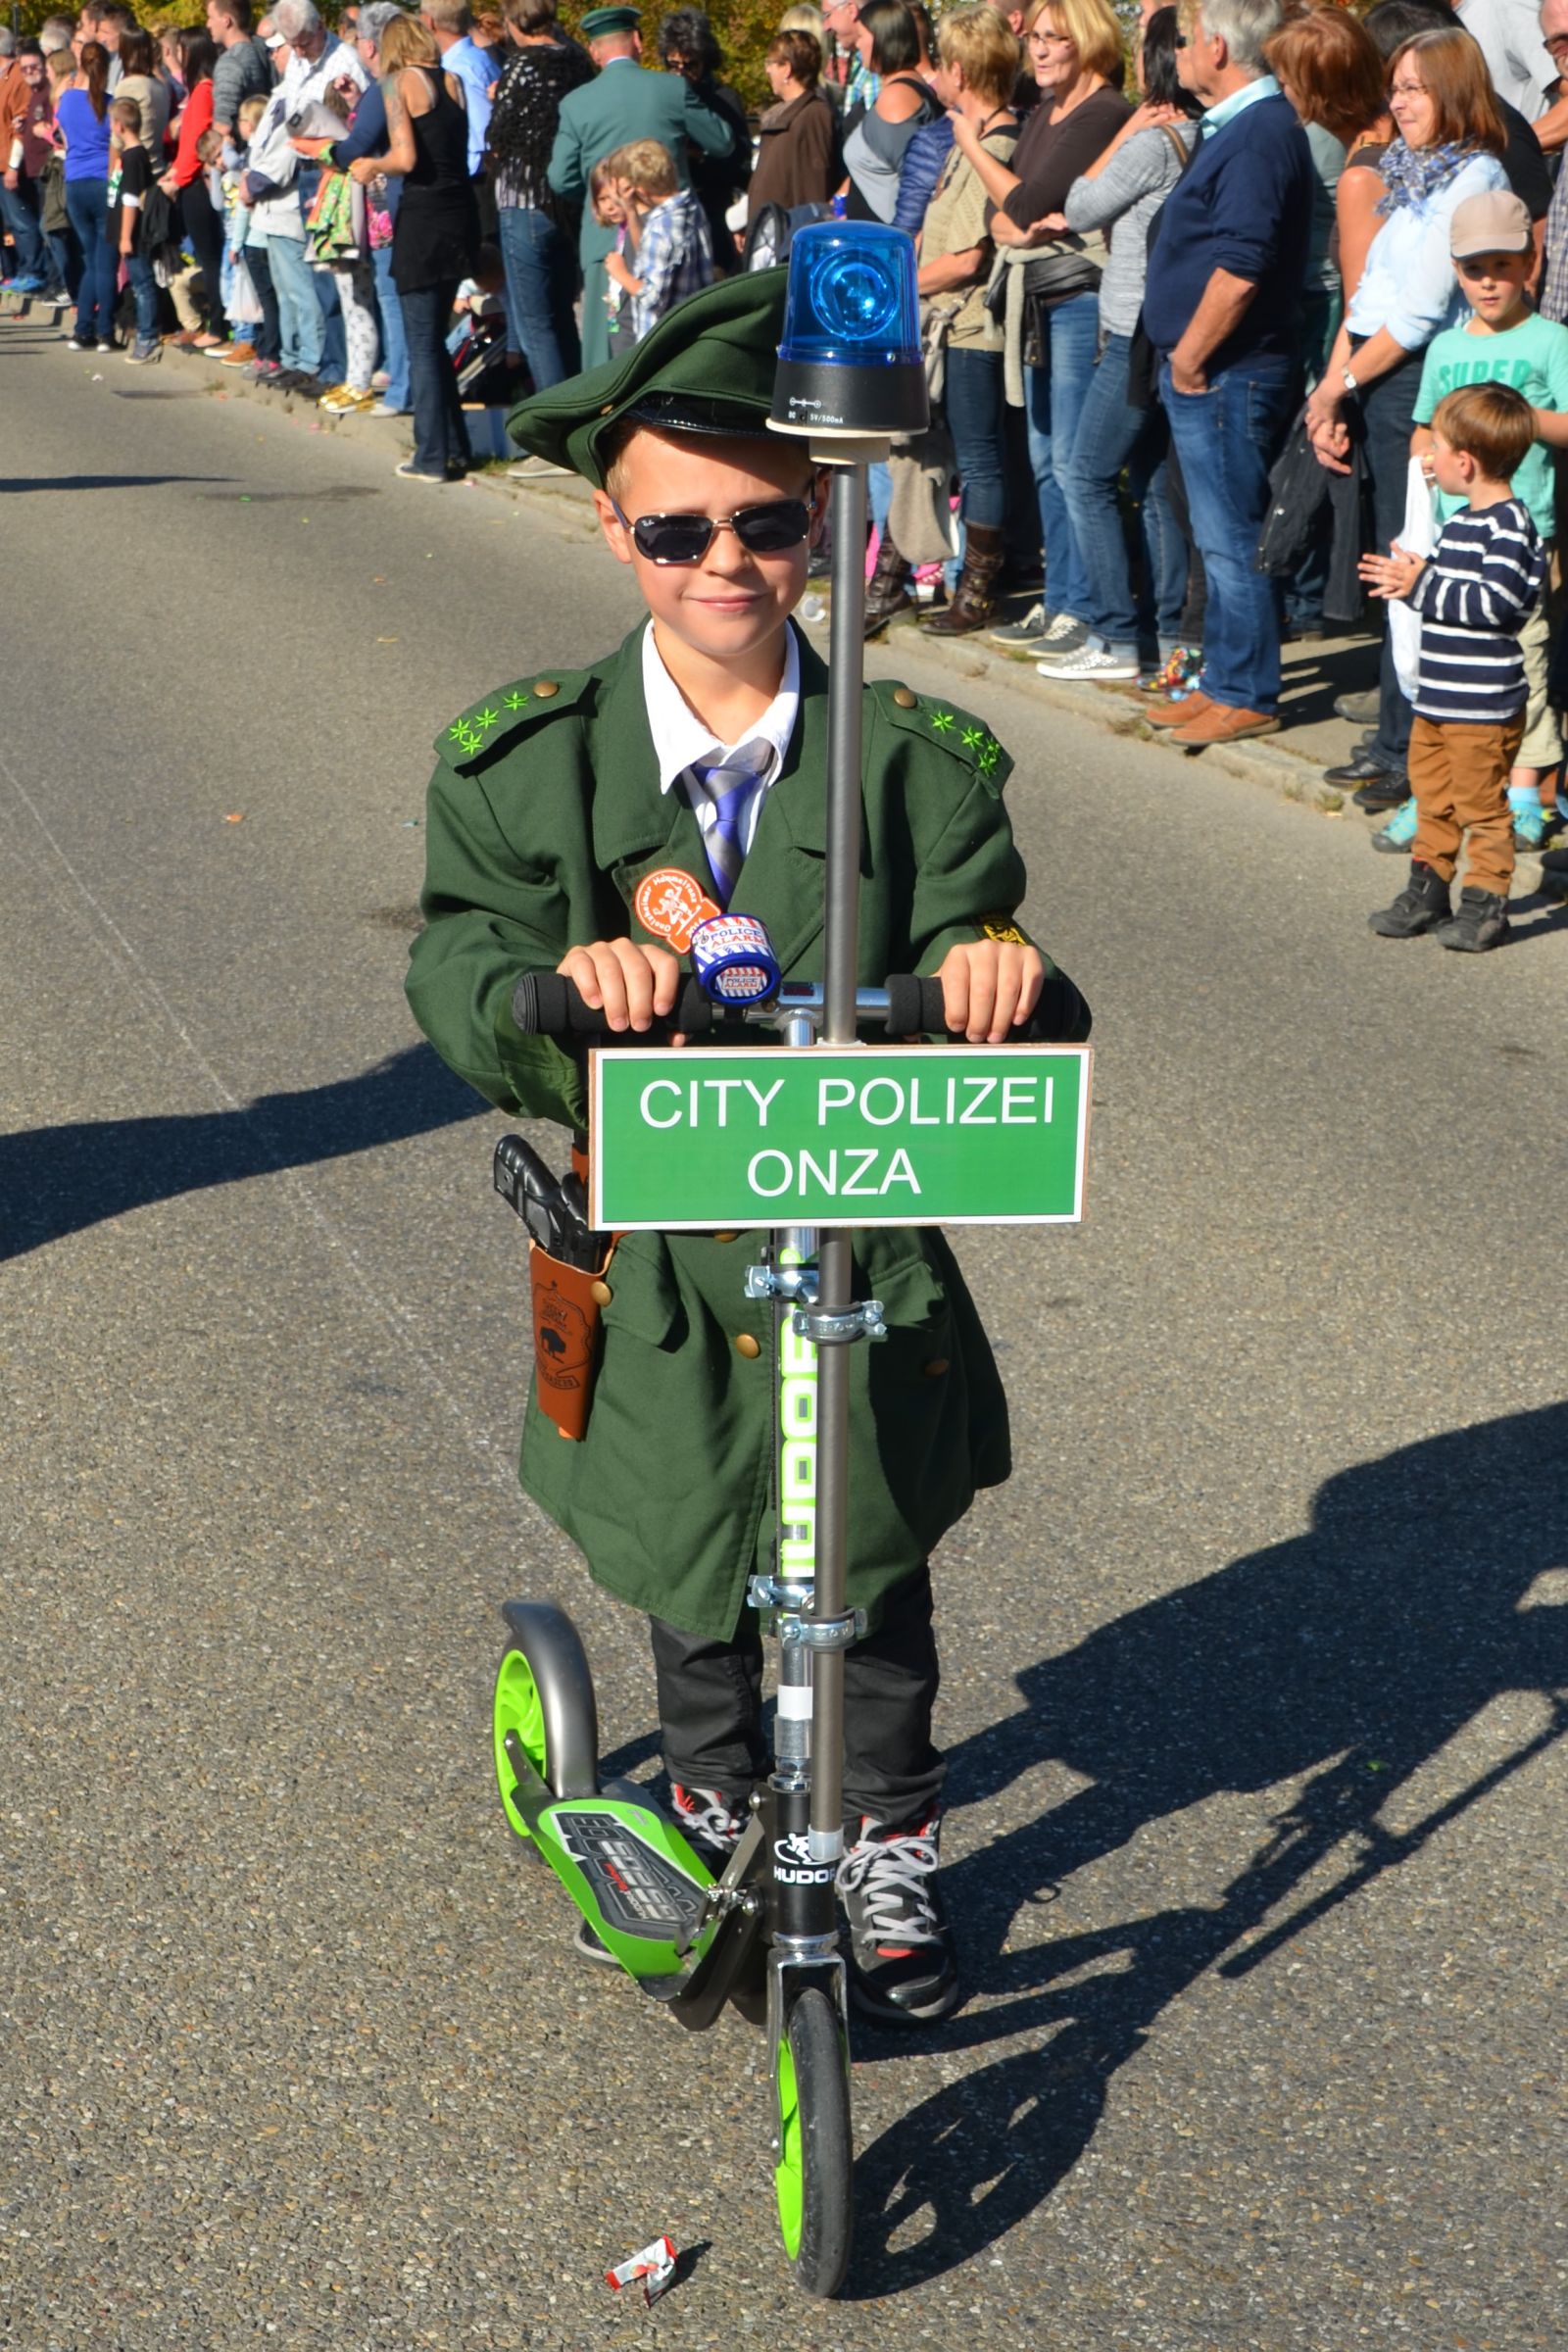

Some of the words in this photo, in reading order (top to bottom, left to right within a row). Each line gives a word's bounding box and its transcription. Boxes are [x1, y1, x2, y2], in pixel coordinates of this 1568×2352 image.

[1438, 360, 1532, 395] SUPER
[710, 927, 762, 941] POLICE
[711, 935, 765, 949] ALARM
[639, 1078, 785, 1129] CITY
[817, 1076, 1054, 1126] POLIZEI
[747, 1148, 922, 1198] ONZA
